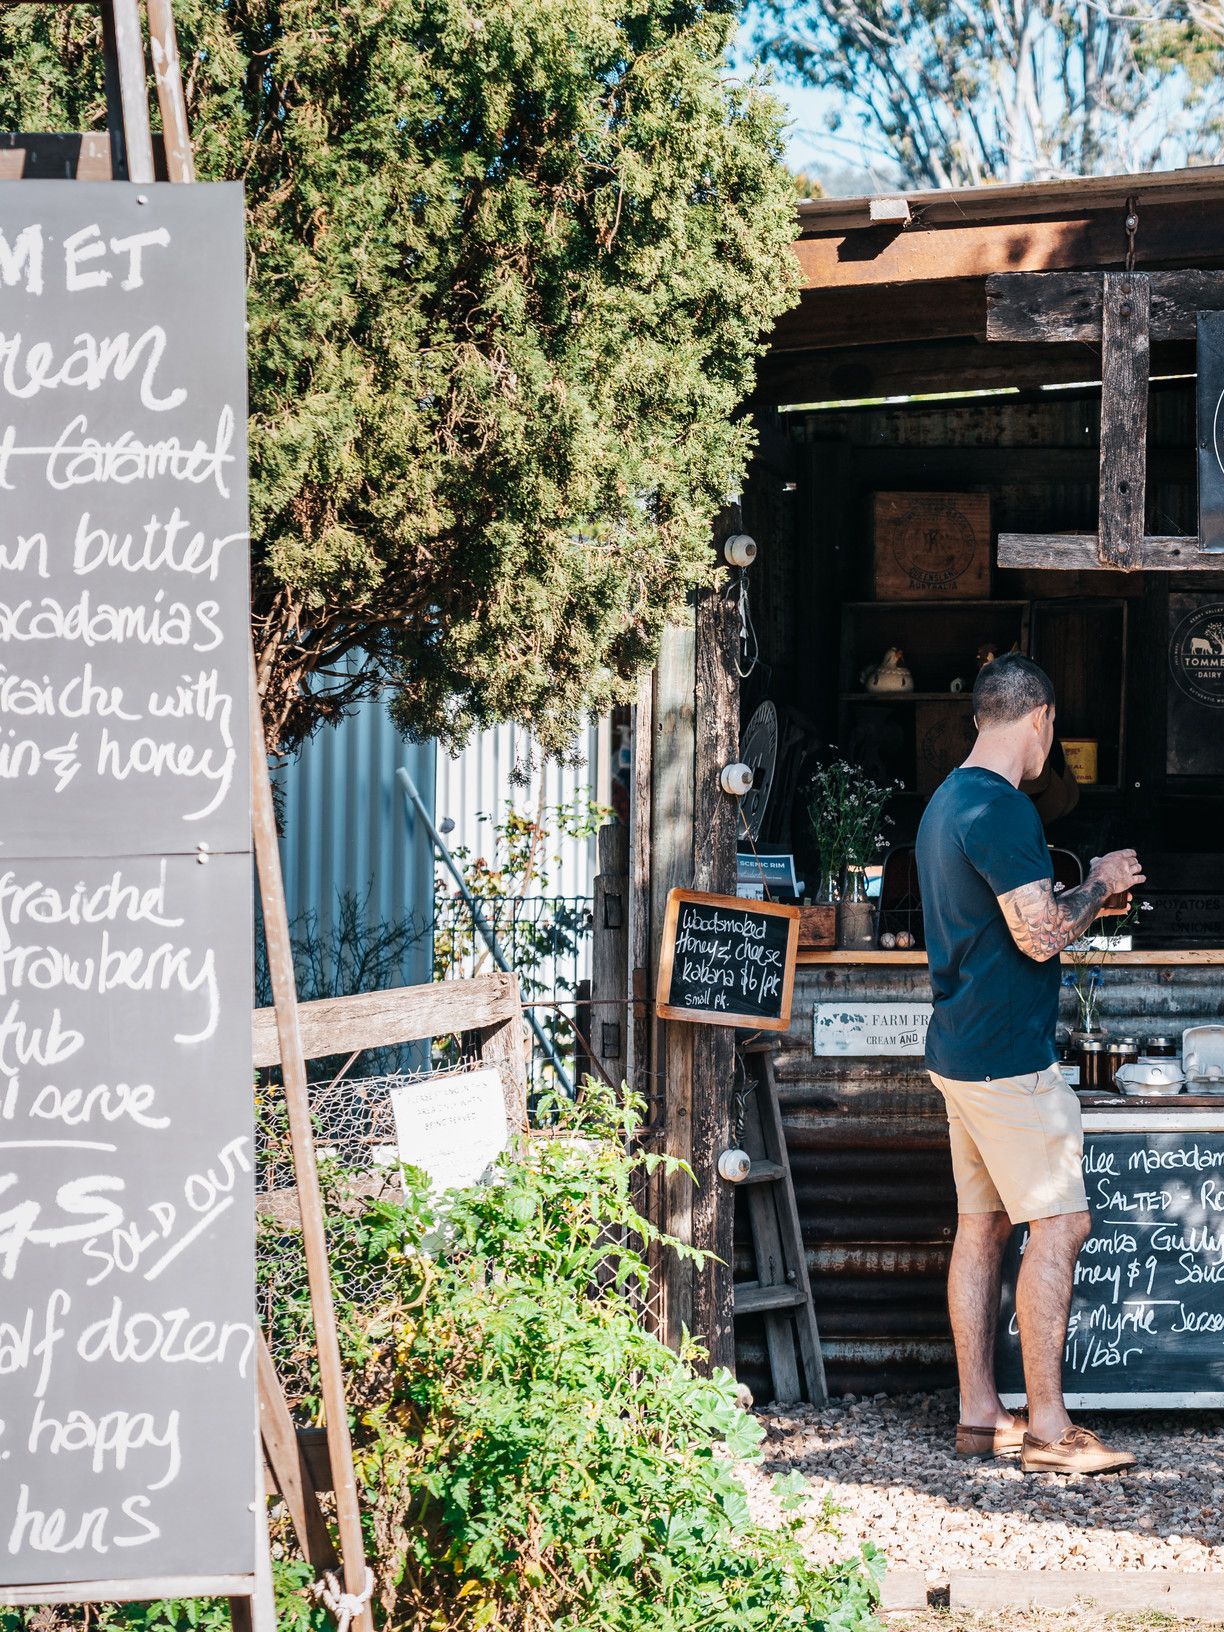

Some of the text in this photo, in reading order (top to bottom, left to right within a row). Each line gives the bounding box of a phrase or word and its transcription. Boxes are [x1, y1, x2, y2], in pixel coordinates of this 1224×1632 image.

[73, 508, 251, 581] butter
[149, 670, 233, 748] with
[97, 727, 237, 821] honey
[676, 928, 718, 966] Honey
[735, 937, 782, 967] cheese
[685, 988, 711, 1006] small
[872, 1014, 908, 1026] FARM
[866, 1036, 896, 1045] CREAM
[899, 1033, 918, 1045] AND
[29, 1083, 171, 1129] serve
[82, 1136, 252, 1286] SOLD OUT
[1127, 1256, 1158, 1296] $9
[77, 1296, 255, 1379] dozen
[1090, 1305, 1158, 1346] Myrtle
[28, 1398, 181, 1490] happy
[9, 1485, 161, 1555] hens
